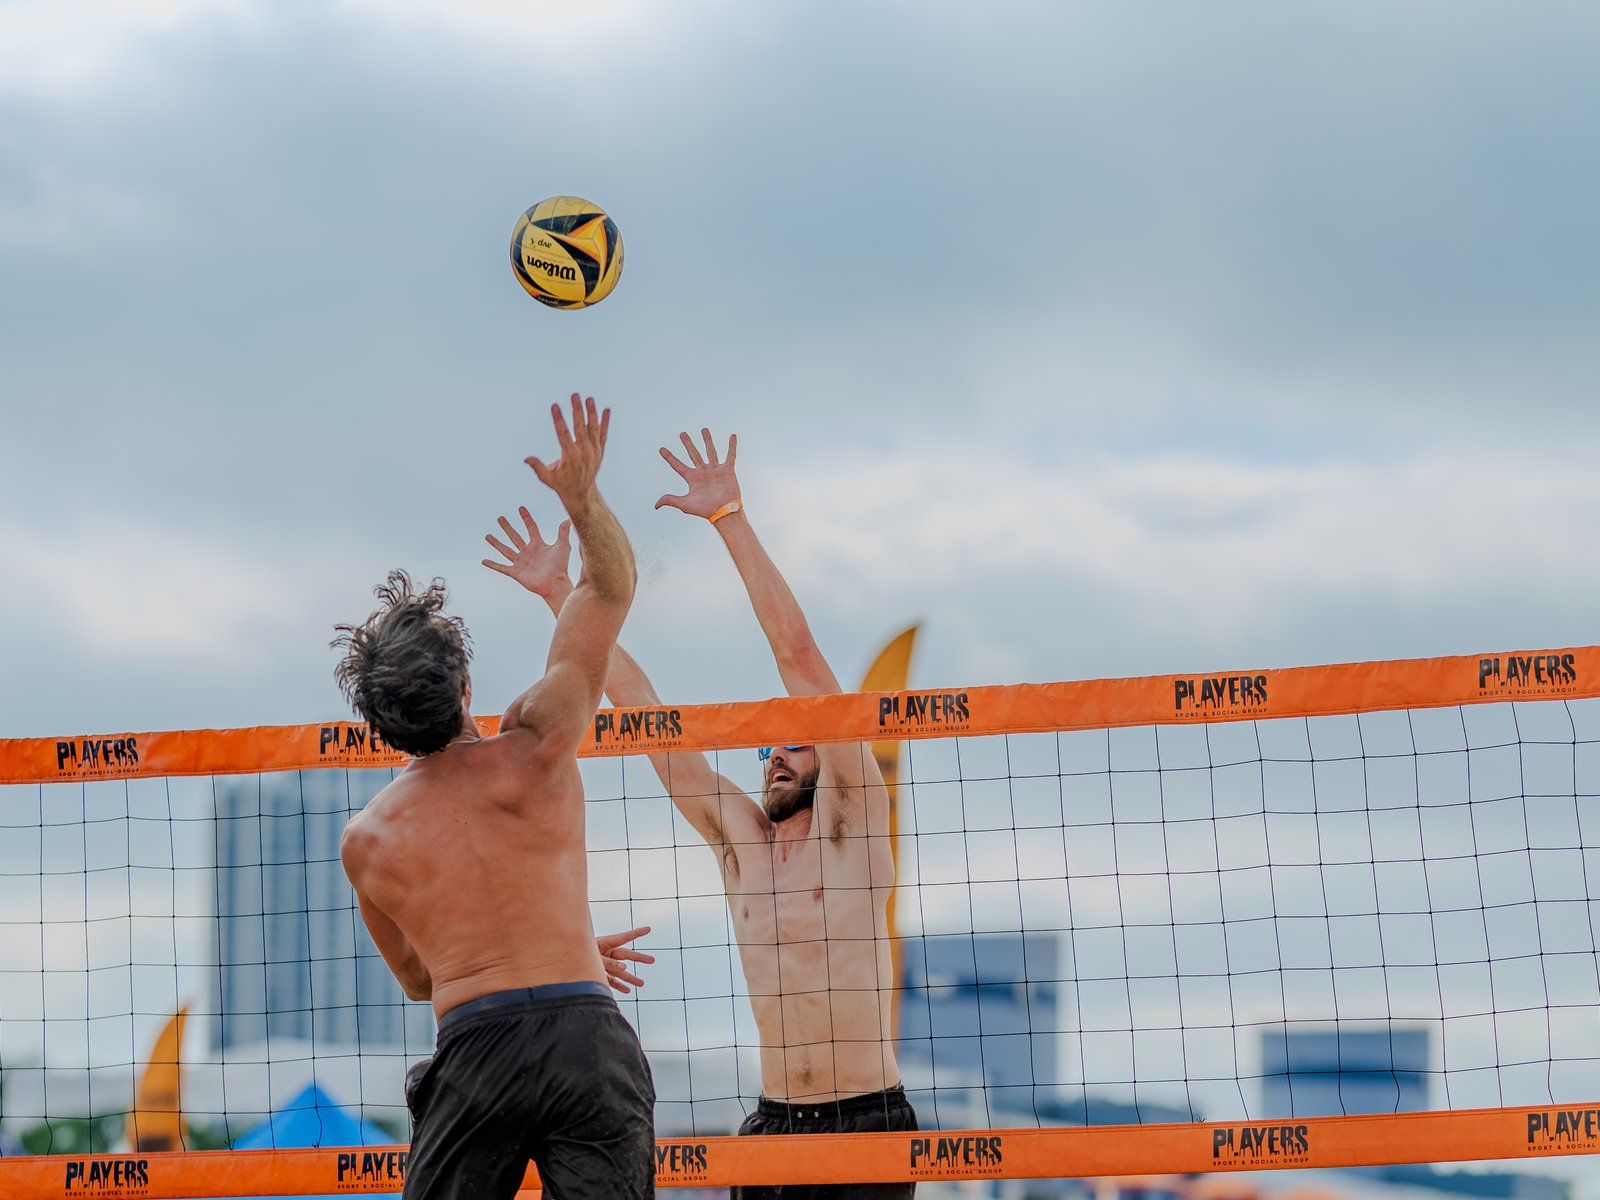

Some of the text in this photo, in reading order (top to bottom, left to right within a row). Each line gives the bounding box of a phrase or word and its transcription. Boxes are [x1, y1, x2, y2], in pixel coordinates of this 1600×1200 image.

[526, 255, 577, 281] Wilson
[1479, 653, 1576, 689] PLAYERS
[1174, 675, 1267, 710] PLAYERS
[594, 709, 682, 743] PLAYERS
[879, 693, 970, 726] PLAYERS
[57, 737, 139, 770] PLAYERS
[320, 726, 398, 755] PLAYE
[1213, 1125, 1308, 1158] PLAYERS
[1527, 1110, 1600, 1143] PLAYE
[337, 1151, 410, 1182] PLAYER
[655, 1144, 707, 1174] YERS
[910, 1136, 1002, 1168] PLAYERS
[65, 1160, 149, 1190] PLAYERS
